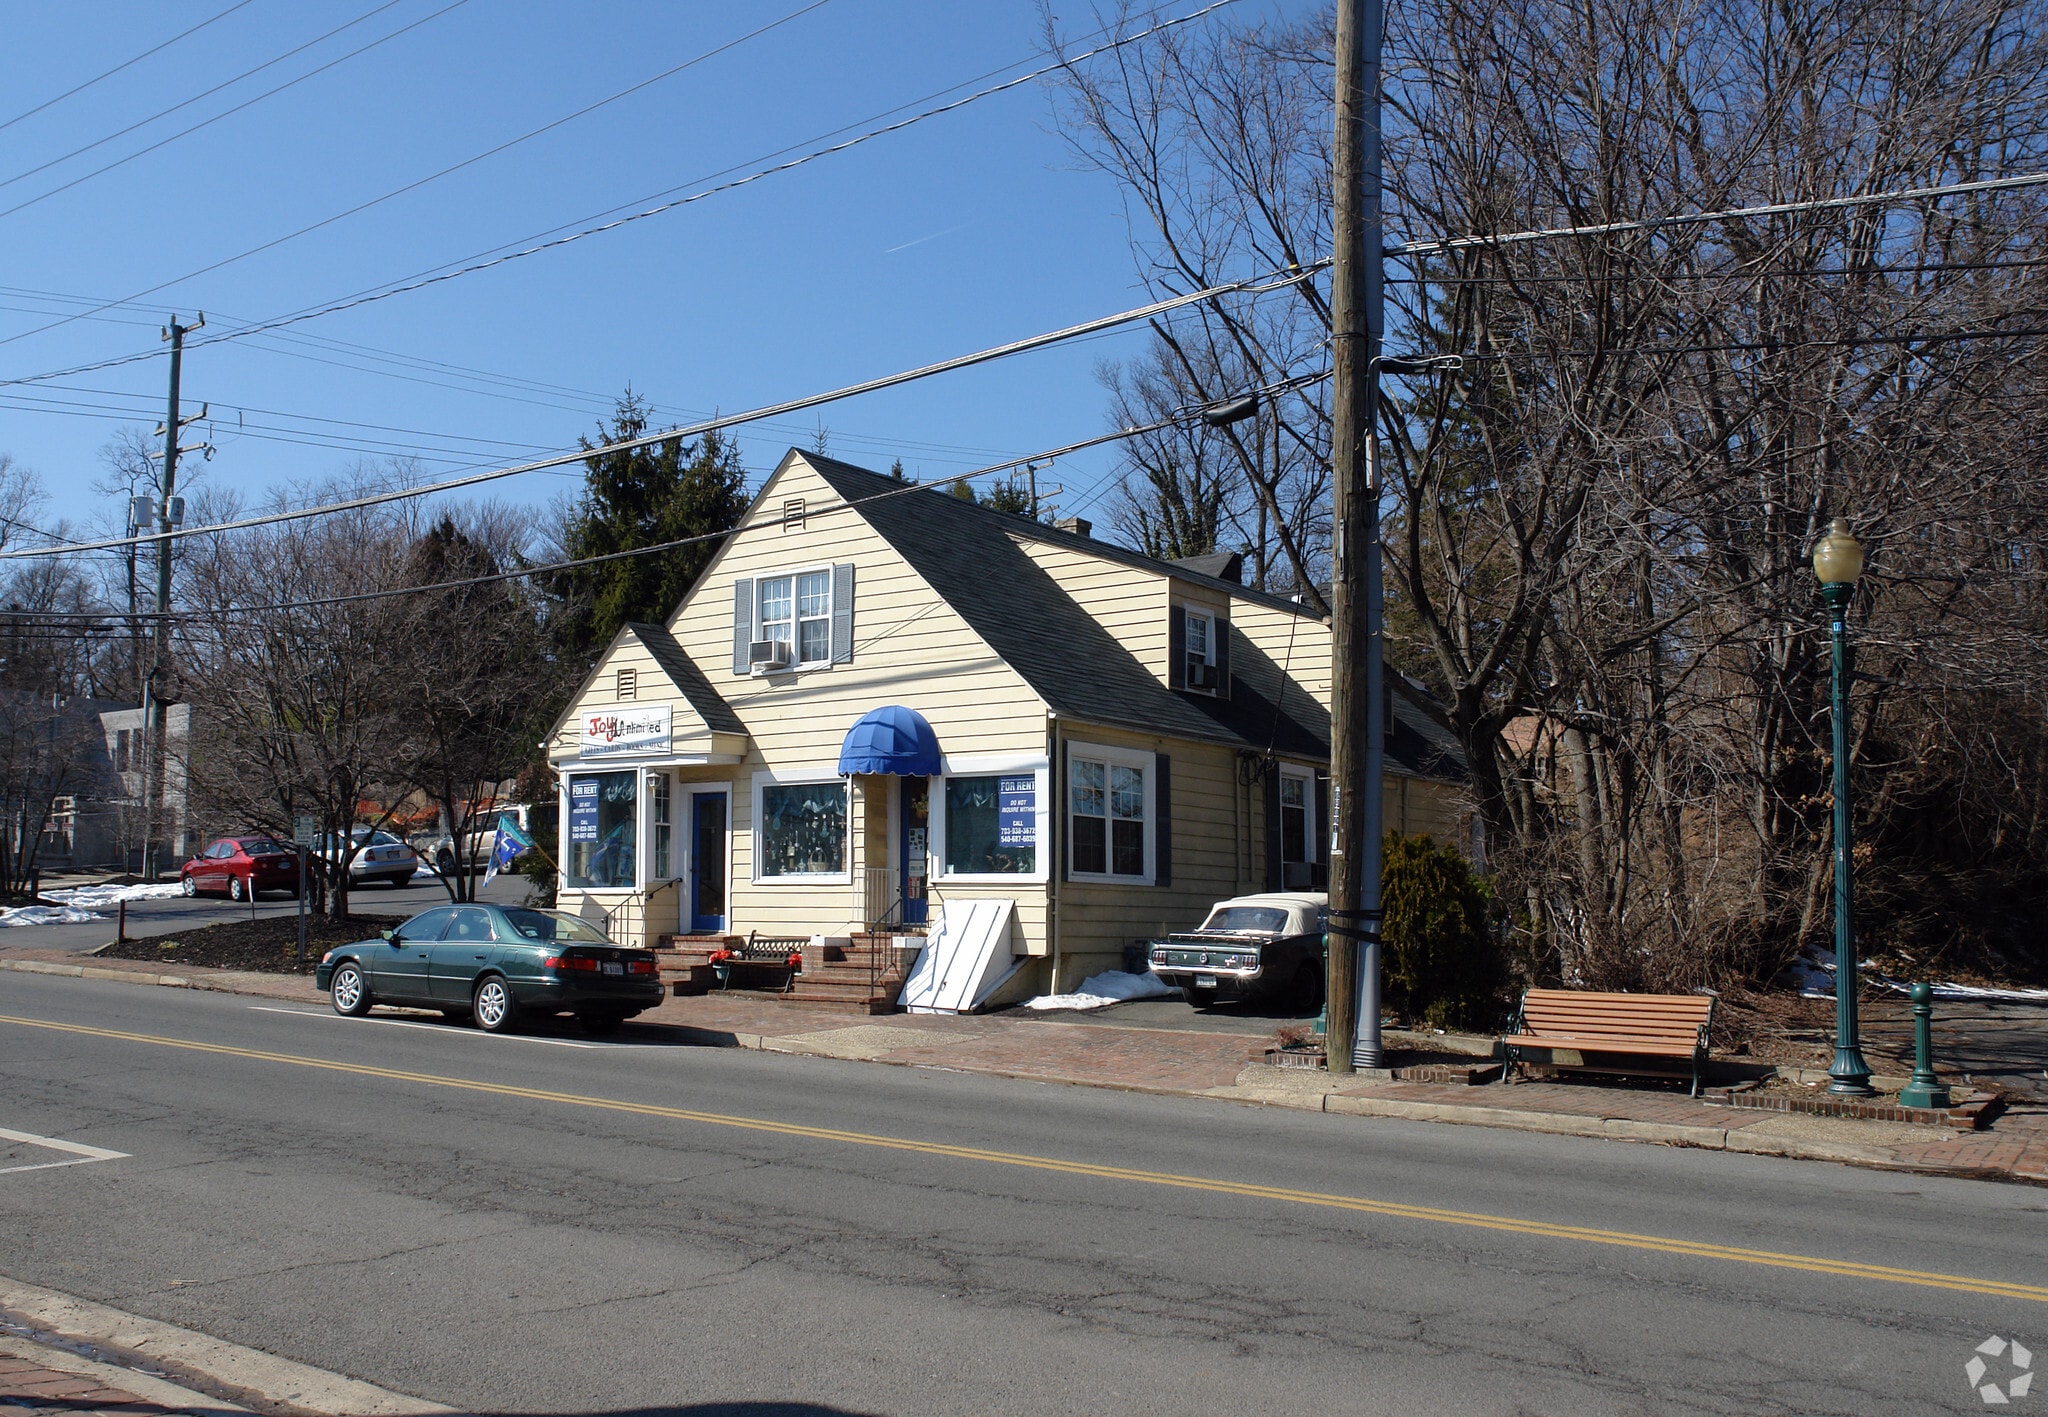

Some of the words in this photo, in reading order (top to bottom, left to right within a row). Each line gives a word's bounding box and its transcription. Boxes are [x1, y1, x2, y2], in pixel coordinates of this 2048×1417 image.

[572, 787, 583, 795] FOR
[584, 786, 597, 794] RENT
[1001, 782, 1015, 791] FOR
[1017, 781, 1035, 790] RENT
